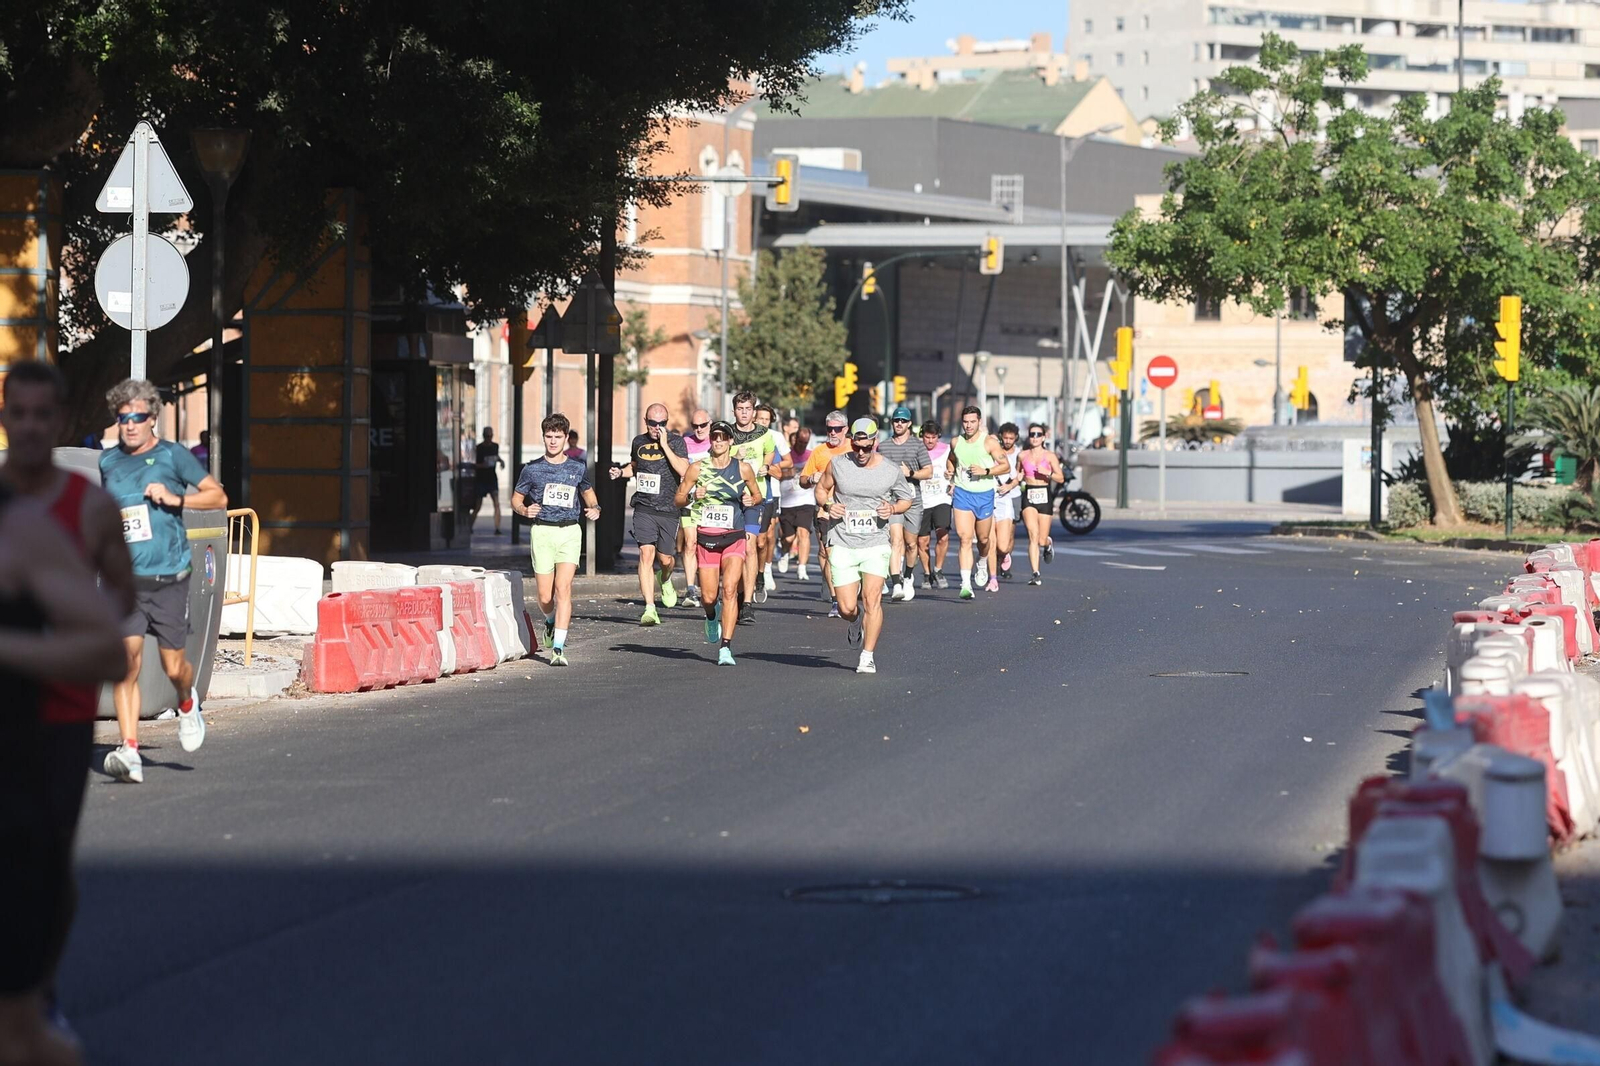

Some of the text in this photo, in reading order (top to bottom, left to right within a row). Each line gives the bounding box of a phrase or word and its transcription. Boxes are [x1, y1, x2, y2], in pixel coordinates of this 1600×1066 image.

[640, 480, 656, 488] 510
[549, 491, 570, 501] 359
[706, 512, 728, 521] 485
[850, 518, 872, 527] 144
